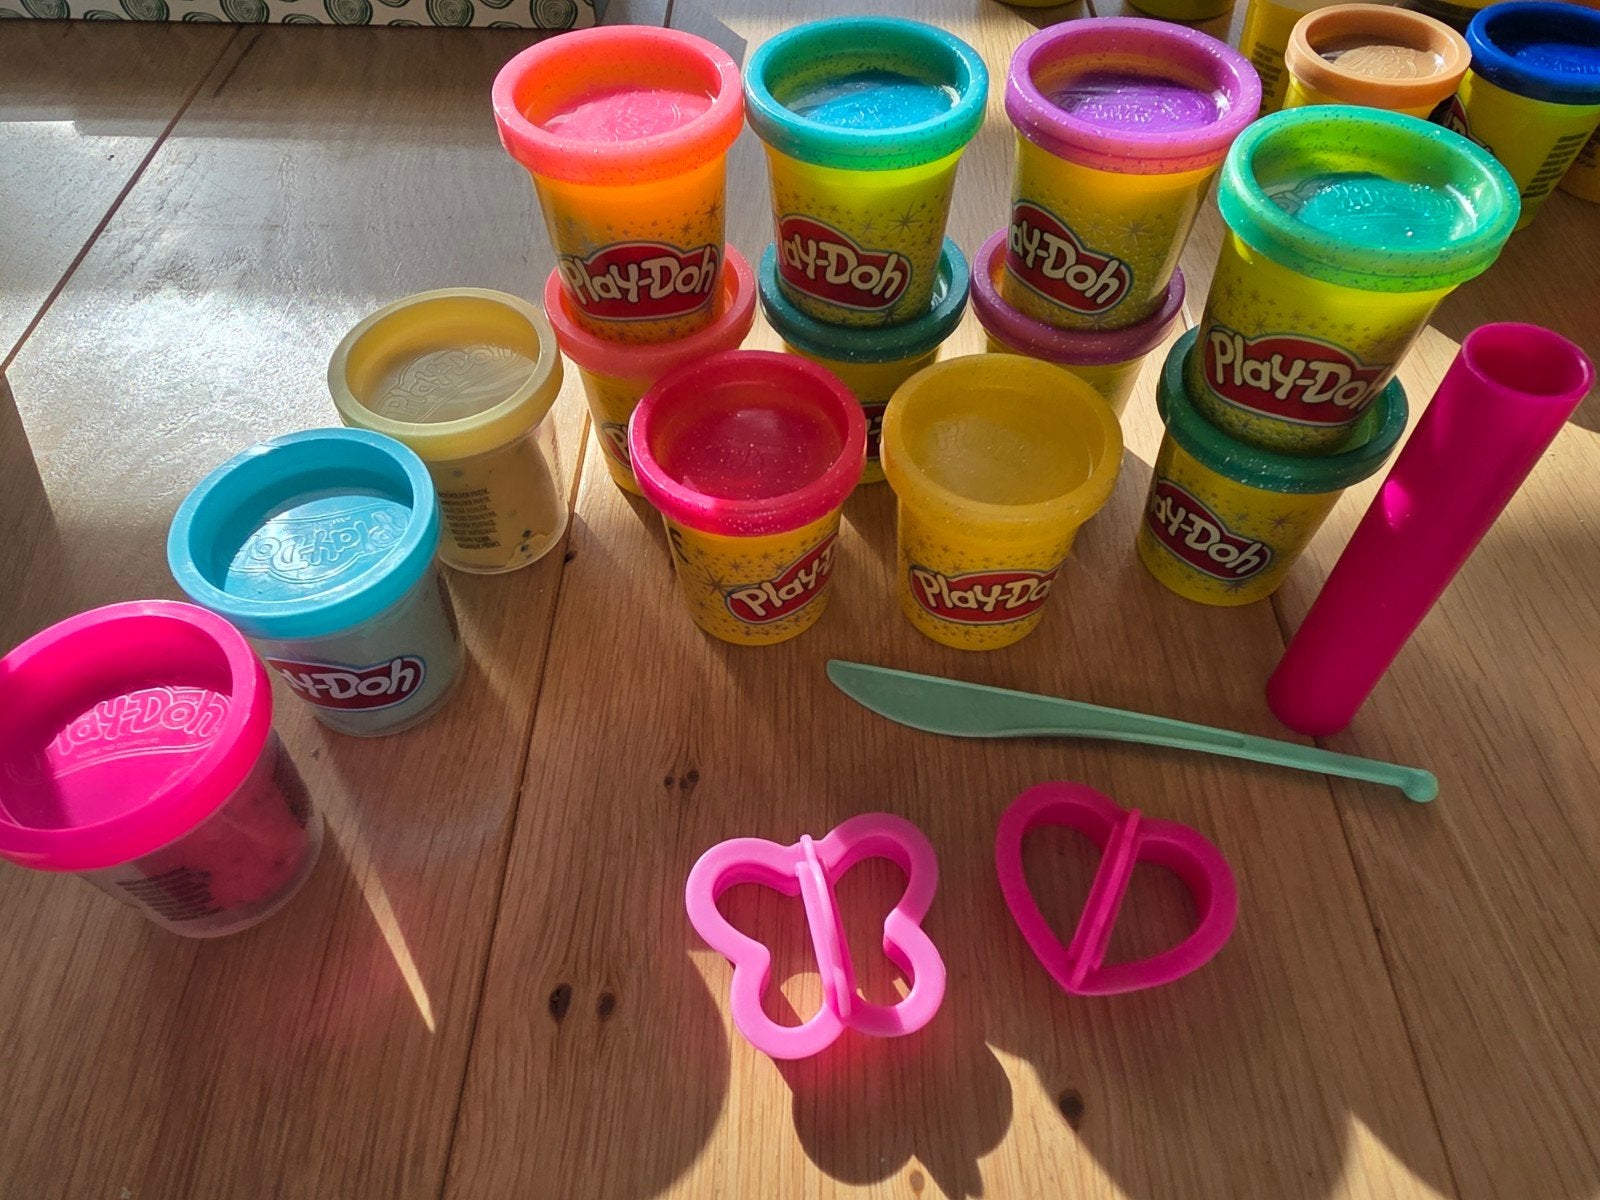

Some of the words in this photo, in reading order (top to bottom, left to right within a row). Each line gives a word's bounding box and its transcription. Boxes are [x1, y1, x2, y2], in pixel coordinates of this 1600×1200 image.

[559, 244, 716, 305] Play-Doh
[783, 233, 903, 299] ay-Doh
[1011, 219, 1120, 305] ay-Doh
[1153, 493, 1262, 575] ay-Doh
[912, 568, 1052, 612] Play-Do
